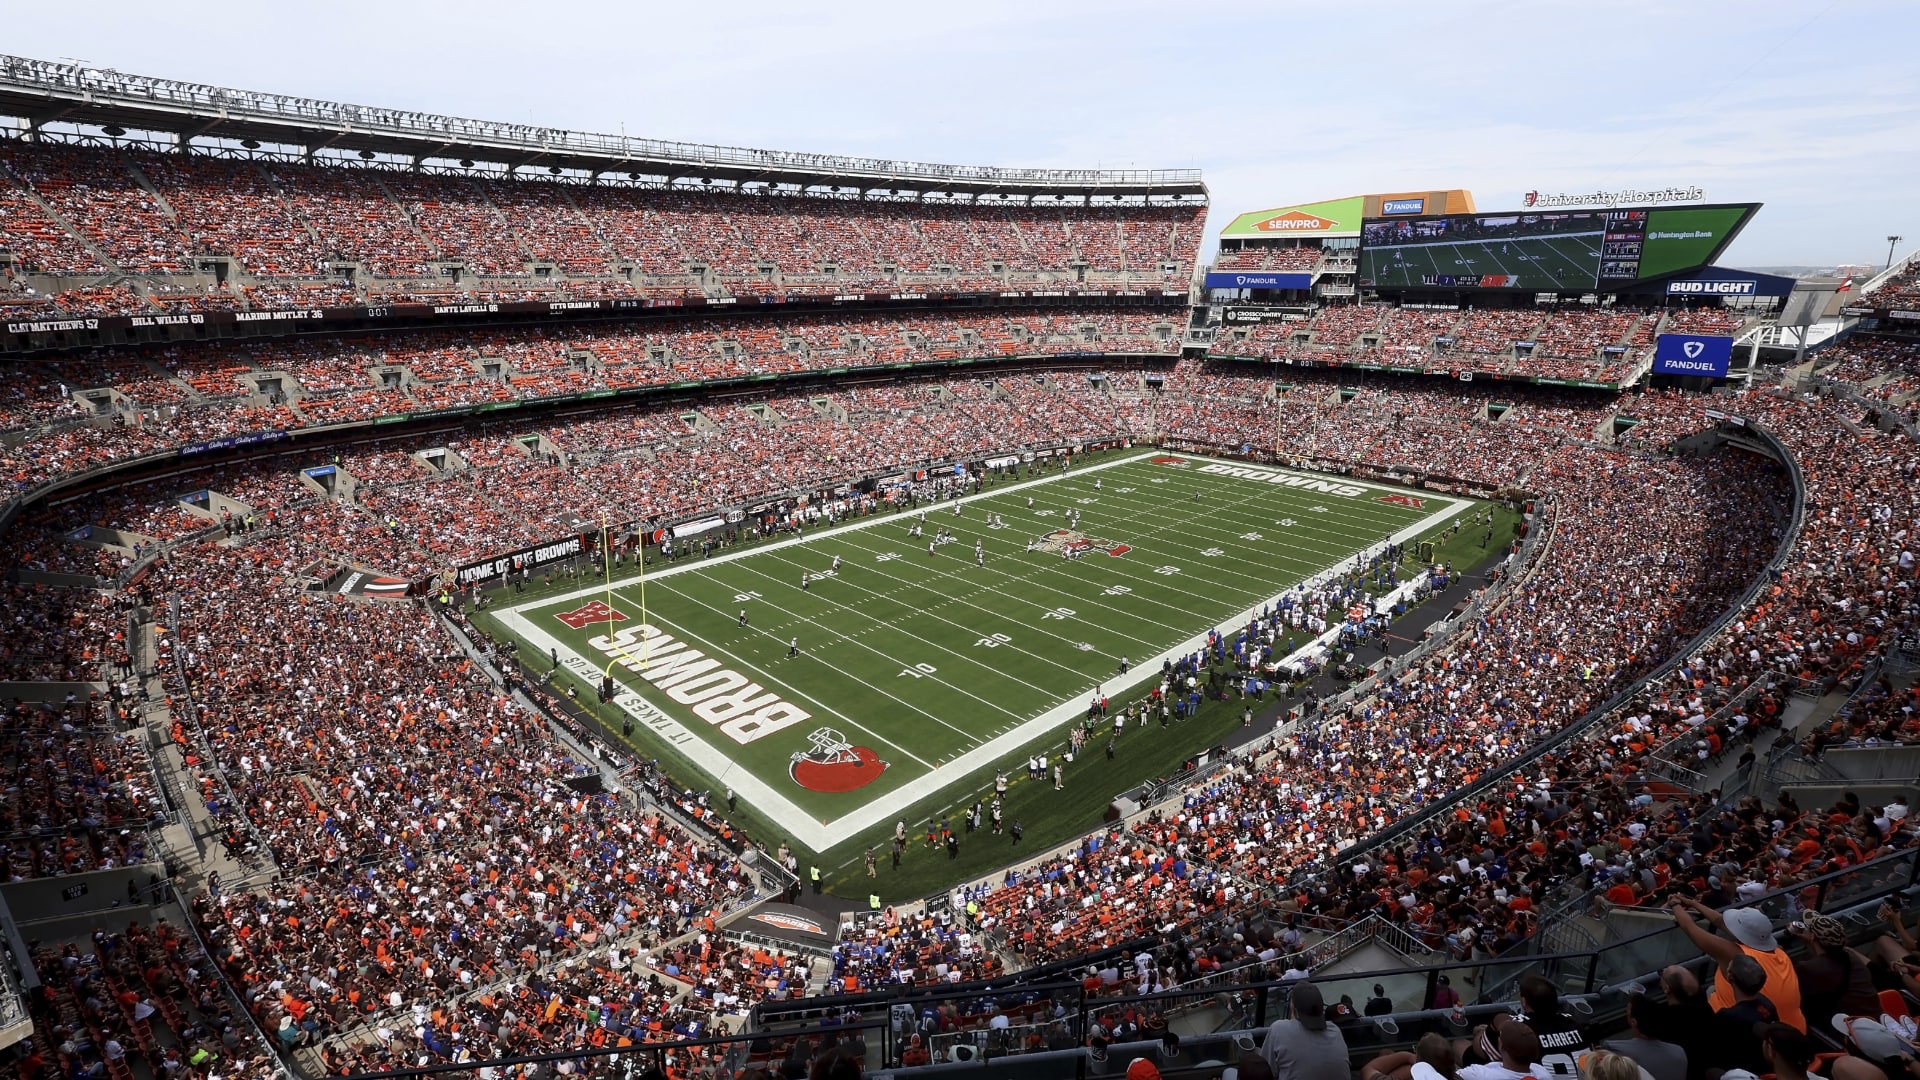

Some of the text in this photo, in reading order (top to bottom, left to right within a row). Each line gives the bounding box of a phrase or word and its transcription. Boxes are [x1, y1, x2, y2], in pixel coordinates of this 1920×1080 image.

[1537, 186, 1703, 207] University Hospitals
[1393, 202, 1422, 211] FANDUEL
[1268, 219, 1320, 230] SERVPRO
[1610, 221, 1616, 230] 7
[1638, 220, 1644, 230] 7
[1658, 229, 1713, 240] Huntington Bank
[1246, 276, 1278, 285] FANDUEL
[1670, 282, 1753, 294] BUD LIGHT
[434, 306, 459, 314] DANTE
[459, 304, 487, 313] LAVELLI
[549, 302, 567, 310] OTTO
[567, 301, 592, 309] GRAHAM
[131, 314, 204, 326] BILL WILLIS 60
[235, 311, 272, 321] MARION
[311, 309, 323, 319] 36
[8, 319, 99, 333] CLAY MATTHEWS 57
[1665, 360, 1716, 371] FANDUEL
[1196, 463, 1369, 498] BROWNS
[459, 562, 494, 583] HOME
[534, 539, 580, 563] BROWNS
[1046, 607, 1077, 620] 30
[978, 632, 1013, 648] 20
[565, 656, 586, 669] US
[580, 669, 604, 682] OF
[901, 662, 938, 679] 10
[587, 624, 815, 745] BROWNS
[623, 698, 673, 731] TAKES
[668, 731, 694, 745] IT
[763, 914, 810, 930] SERVPRO
[892, 1010, 906, 1020] 24
[1538, 1029, 1583, 1048] GARRETT
